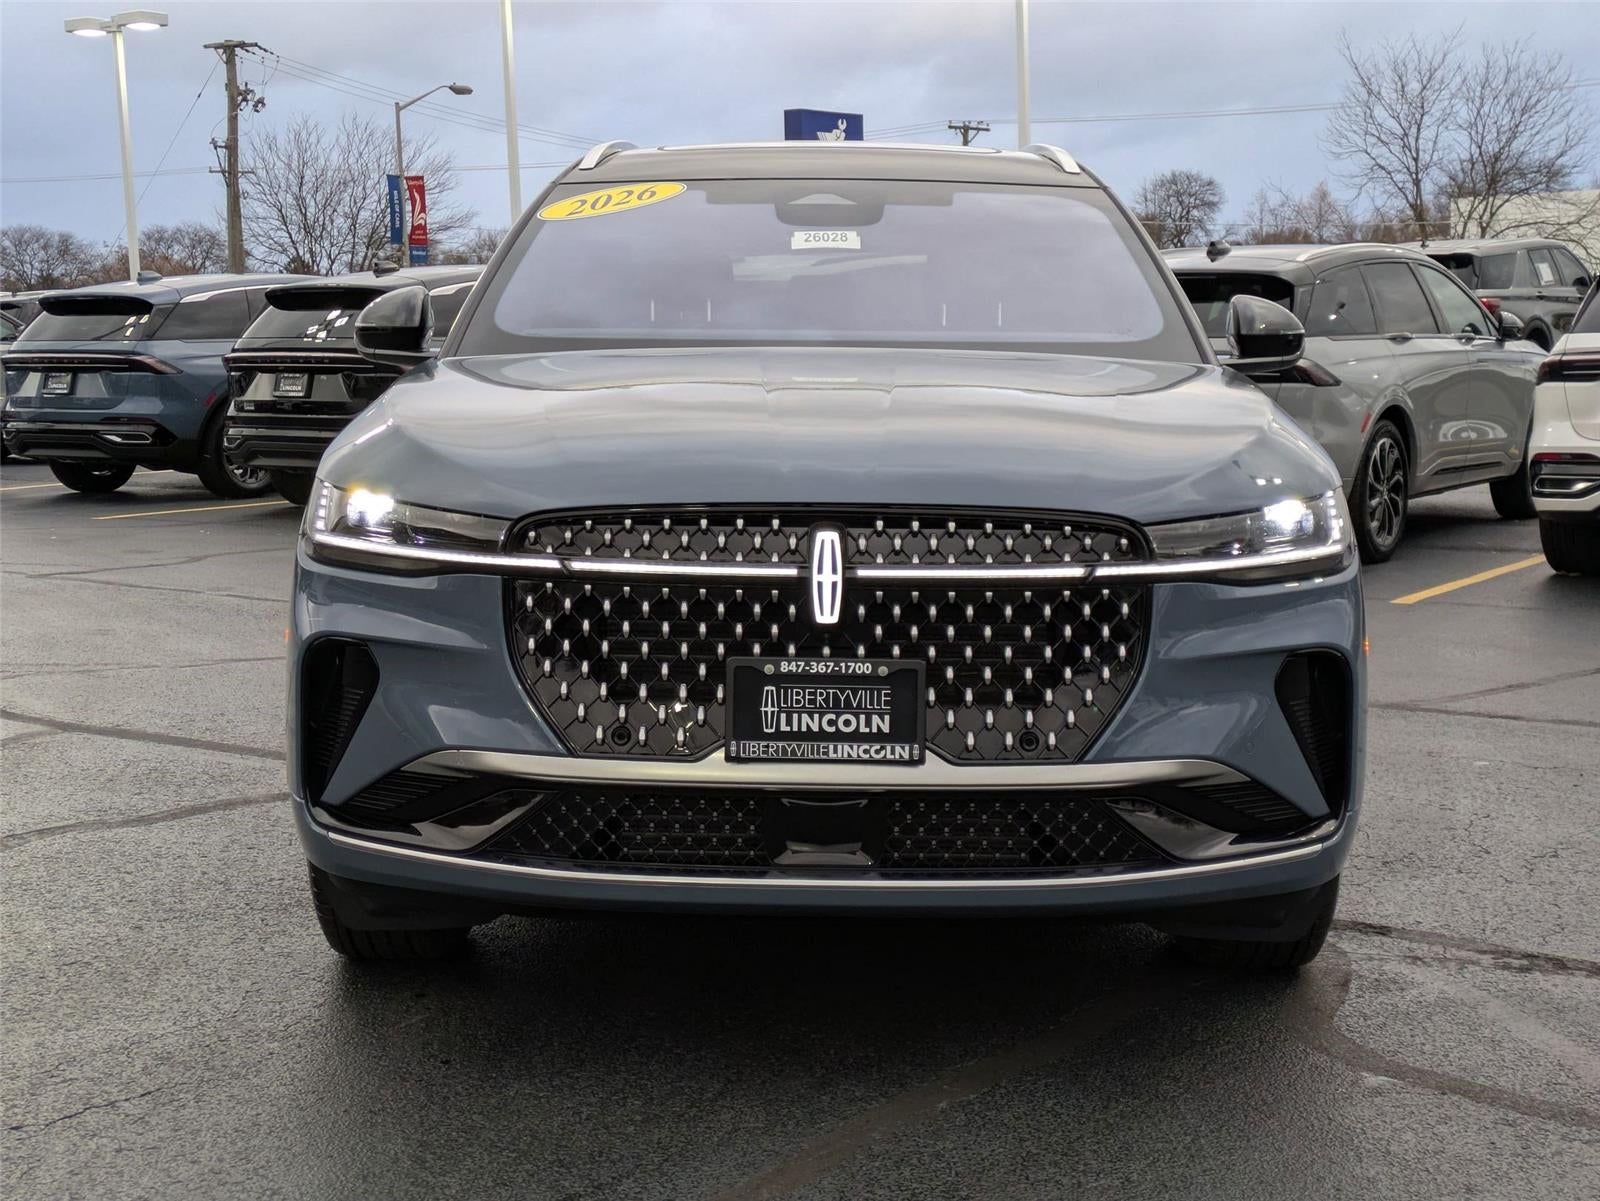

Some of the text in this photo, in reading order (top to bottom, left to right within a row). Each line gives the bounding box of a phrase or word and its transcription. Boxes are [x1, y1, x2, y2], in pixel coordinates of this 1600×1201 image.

[566, 184, 658, 217] 2026
[804, 232, 848, 242] 26028
[780, 661, 872, 674] 847-367-1700
[780, 688, 891, 709] LIBERTYVILLE
[780, 713, 890, 733] LINCOLN
